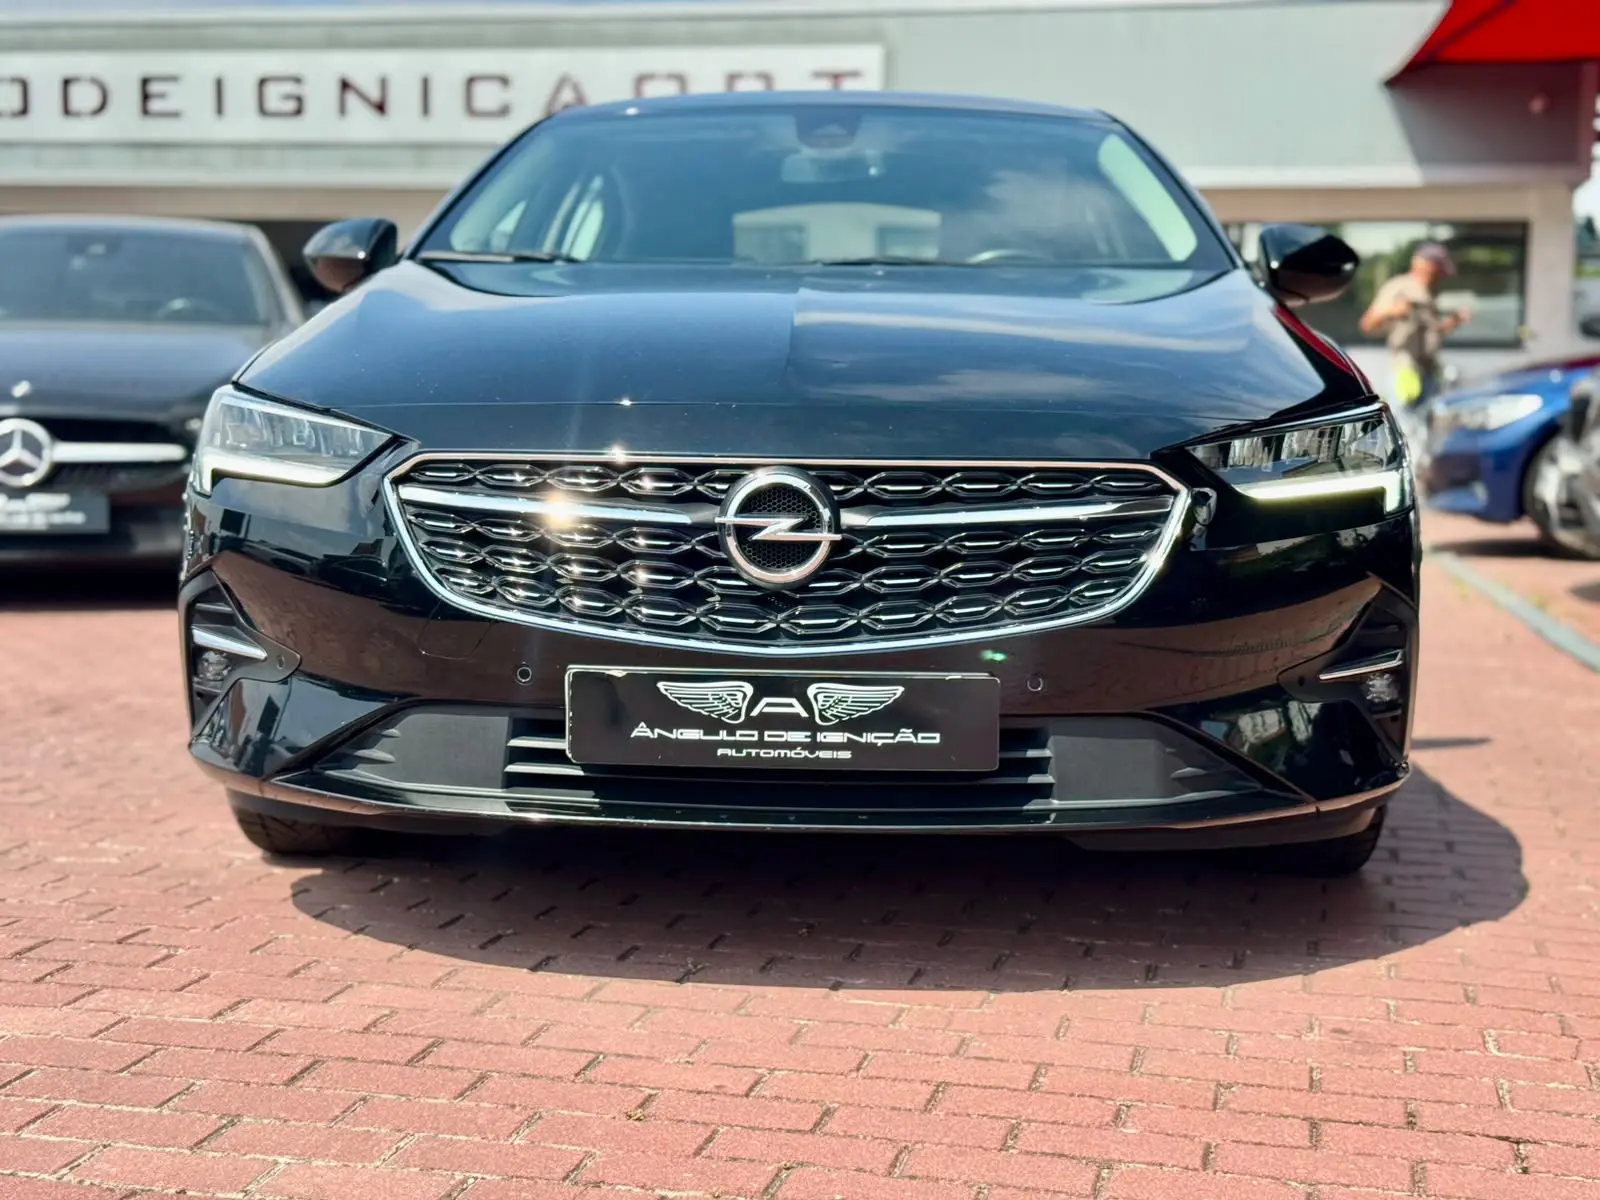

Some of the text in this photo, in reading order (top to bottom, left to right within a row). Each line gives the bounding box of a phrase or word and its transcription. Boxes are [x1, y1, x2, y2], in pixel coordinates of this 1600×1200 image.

[749, 696, 810, 718] A
[631, 720, 941, 747] ÂNGULO DE IGNIÇÃO
[716, 747, 852, 759] AUTOMÓVEIS
